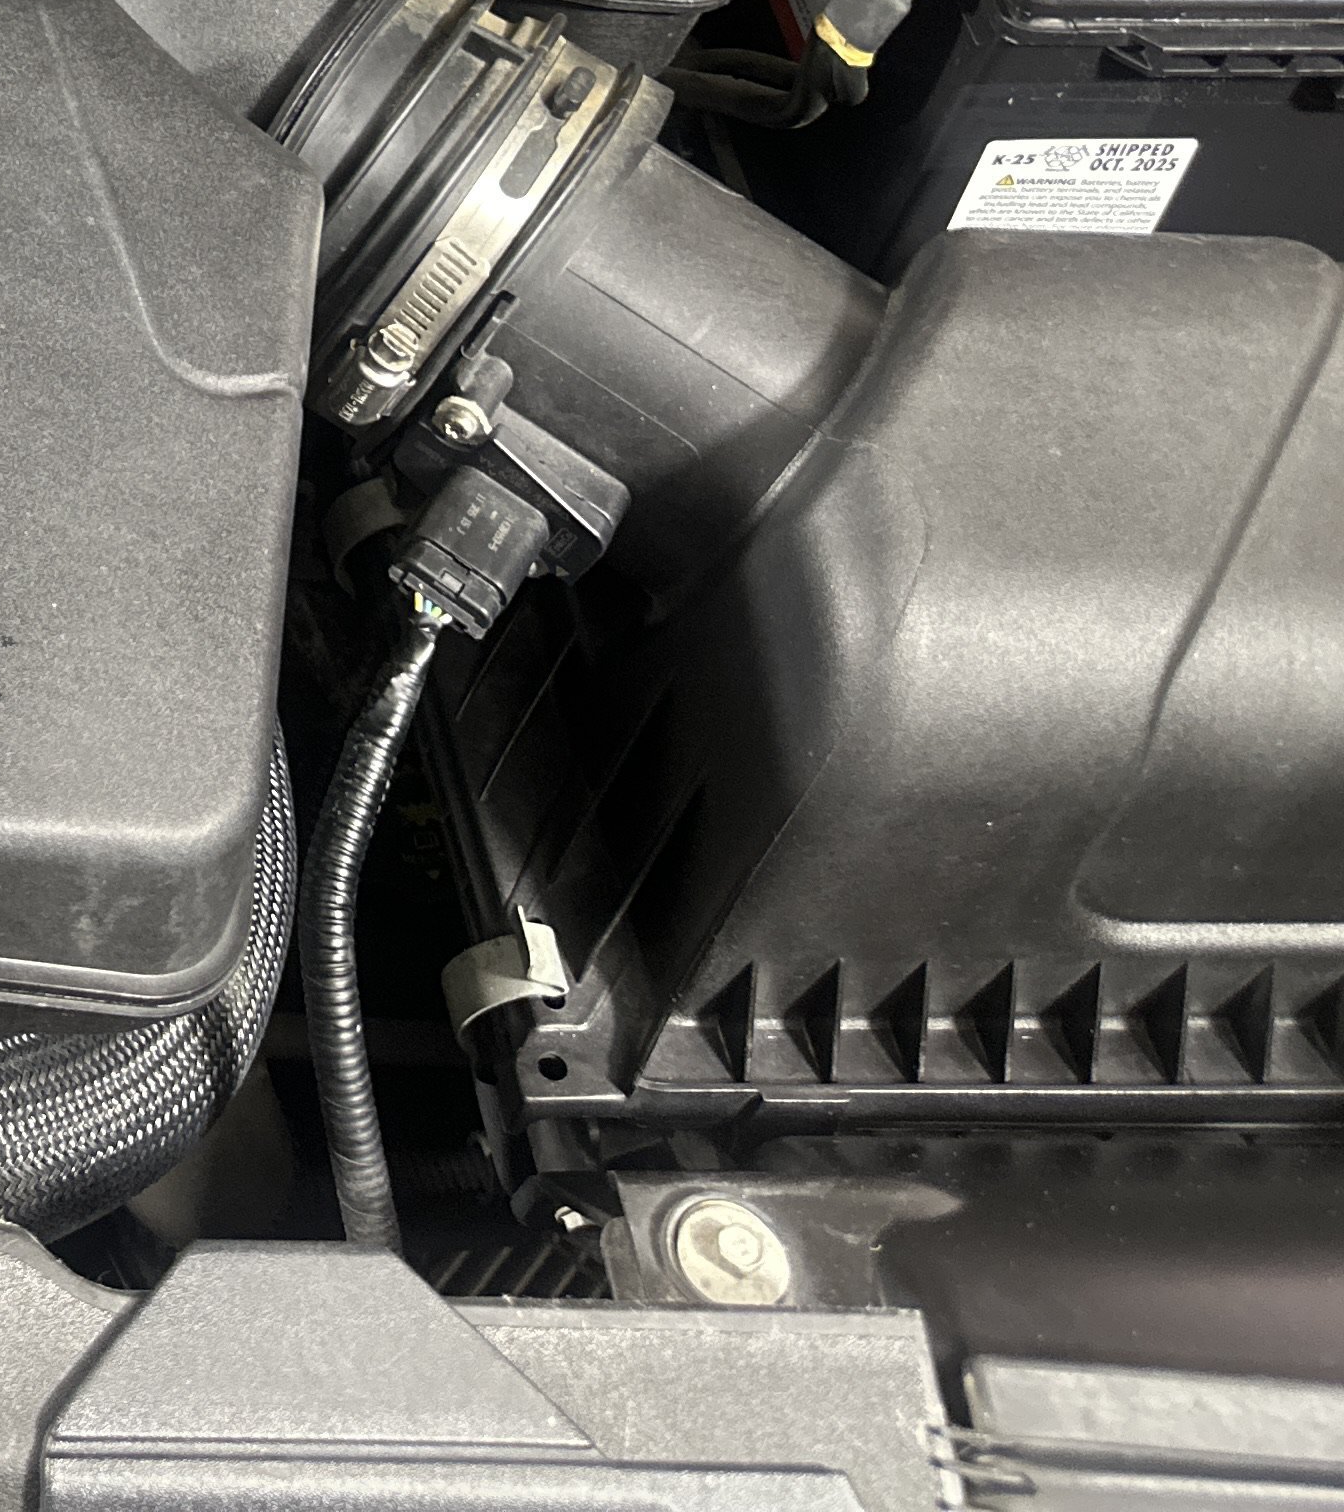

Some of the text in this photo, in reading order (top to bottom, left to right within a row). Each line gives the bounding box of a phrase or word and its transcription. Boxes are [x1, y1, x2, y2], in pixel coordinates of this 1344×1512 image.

[992, 143, 1175, 165] K-25 SHIPPED
[1089, 157, 1179, 171] OCT. 2025
